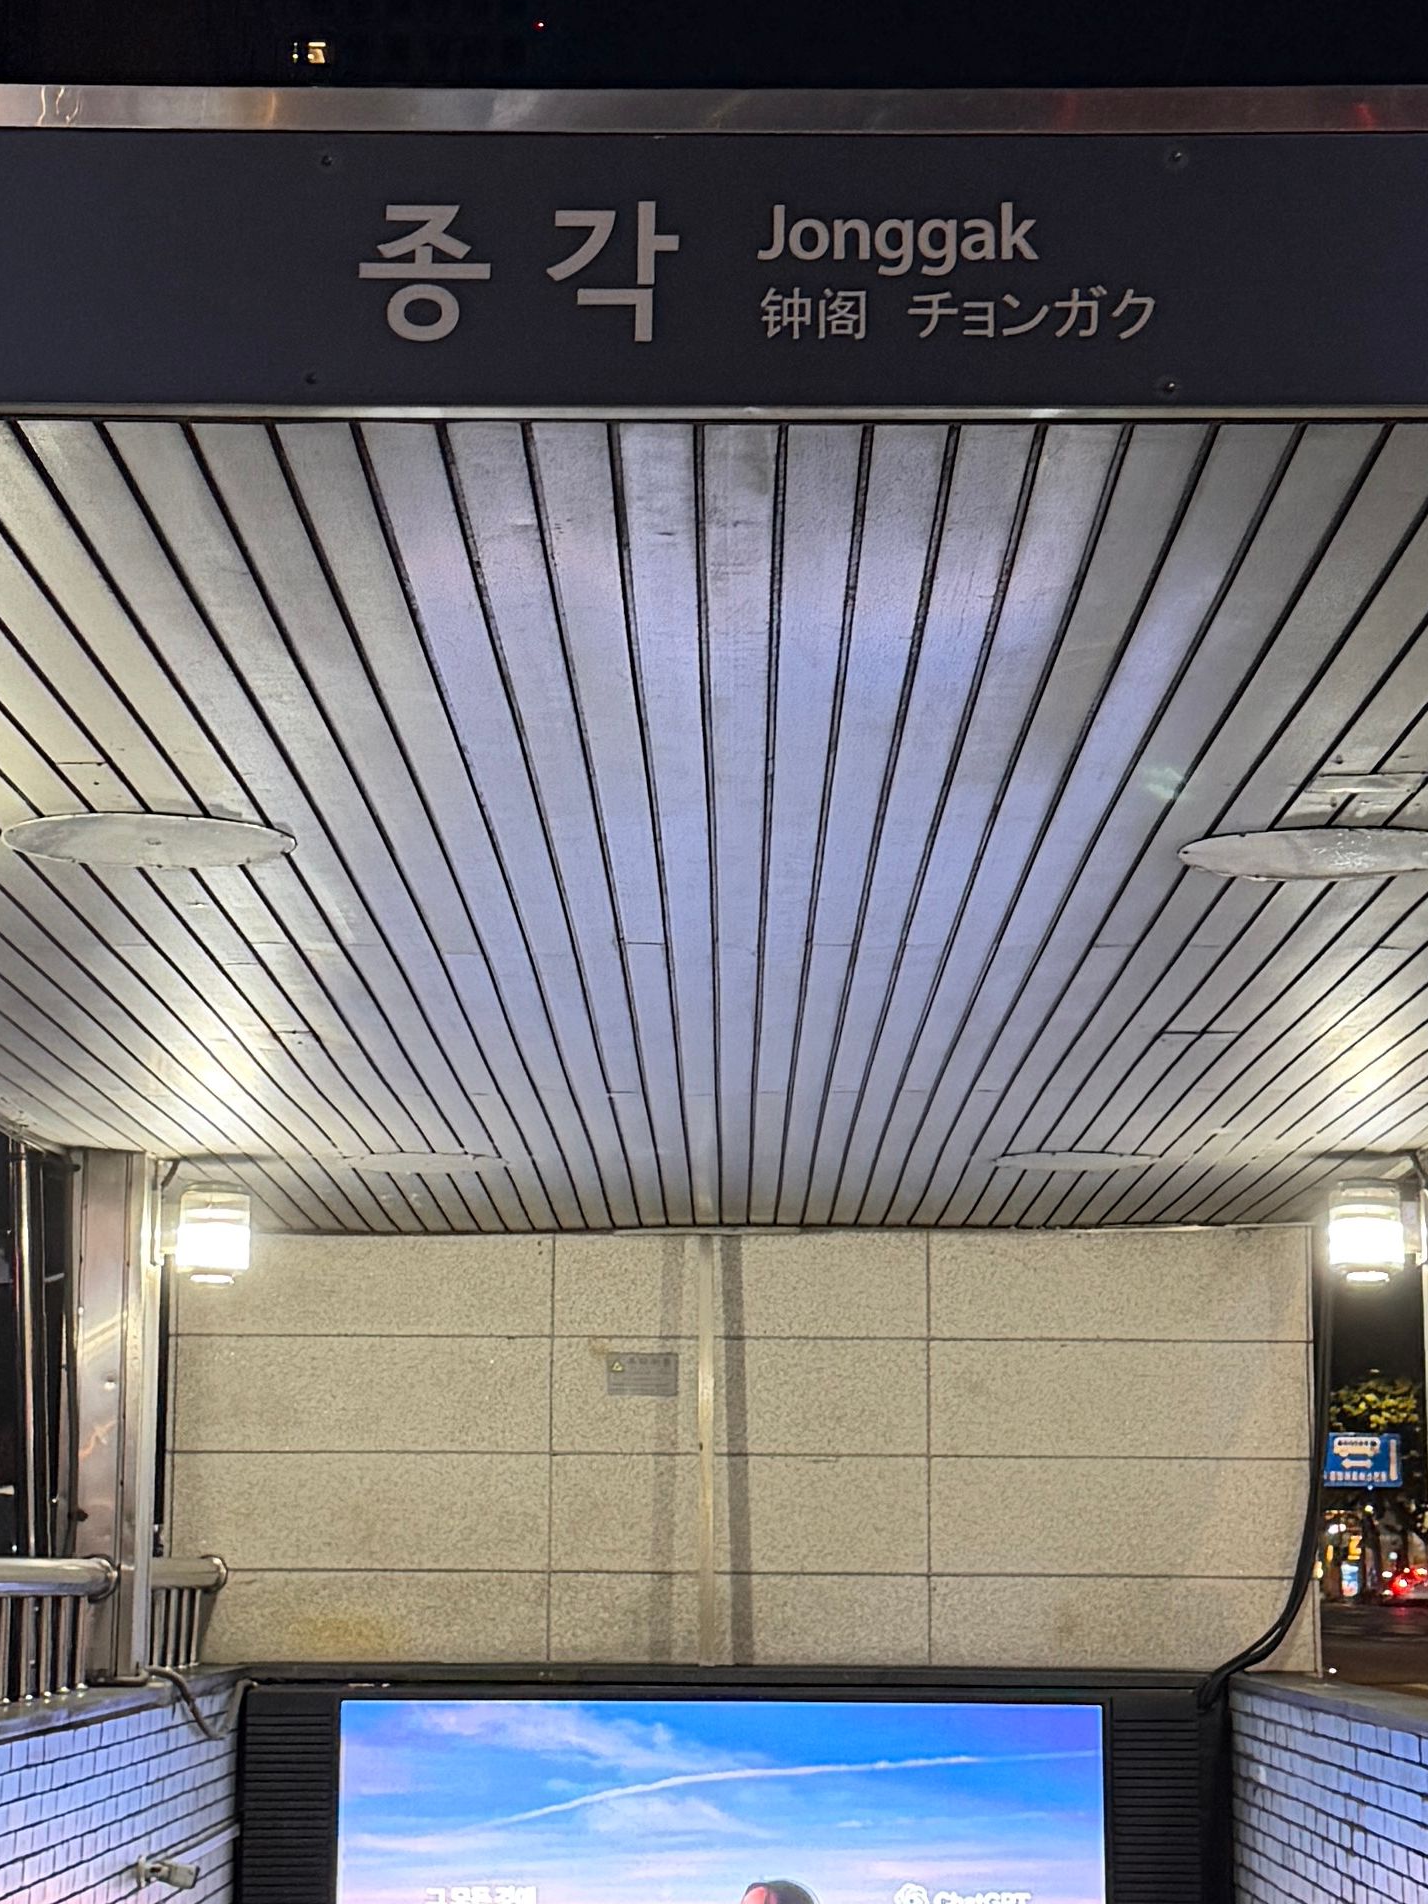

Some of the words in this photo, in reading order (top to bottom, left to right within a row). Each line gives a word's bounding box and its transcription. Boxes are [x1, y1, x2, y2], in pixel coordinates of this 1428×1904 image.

[756, 202, 1039, 277] Jonggak
[907, 287, 1159, 341] チョンガク
